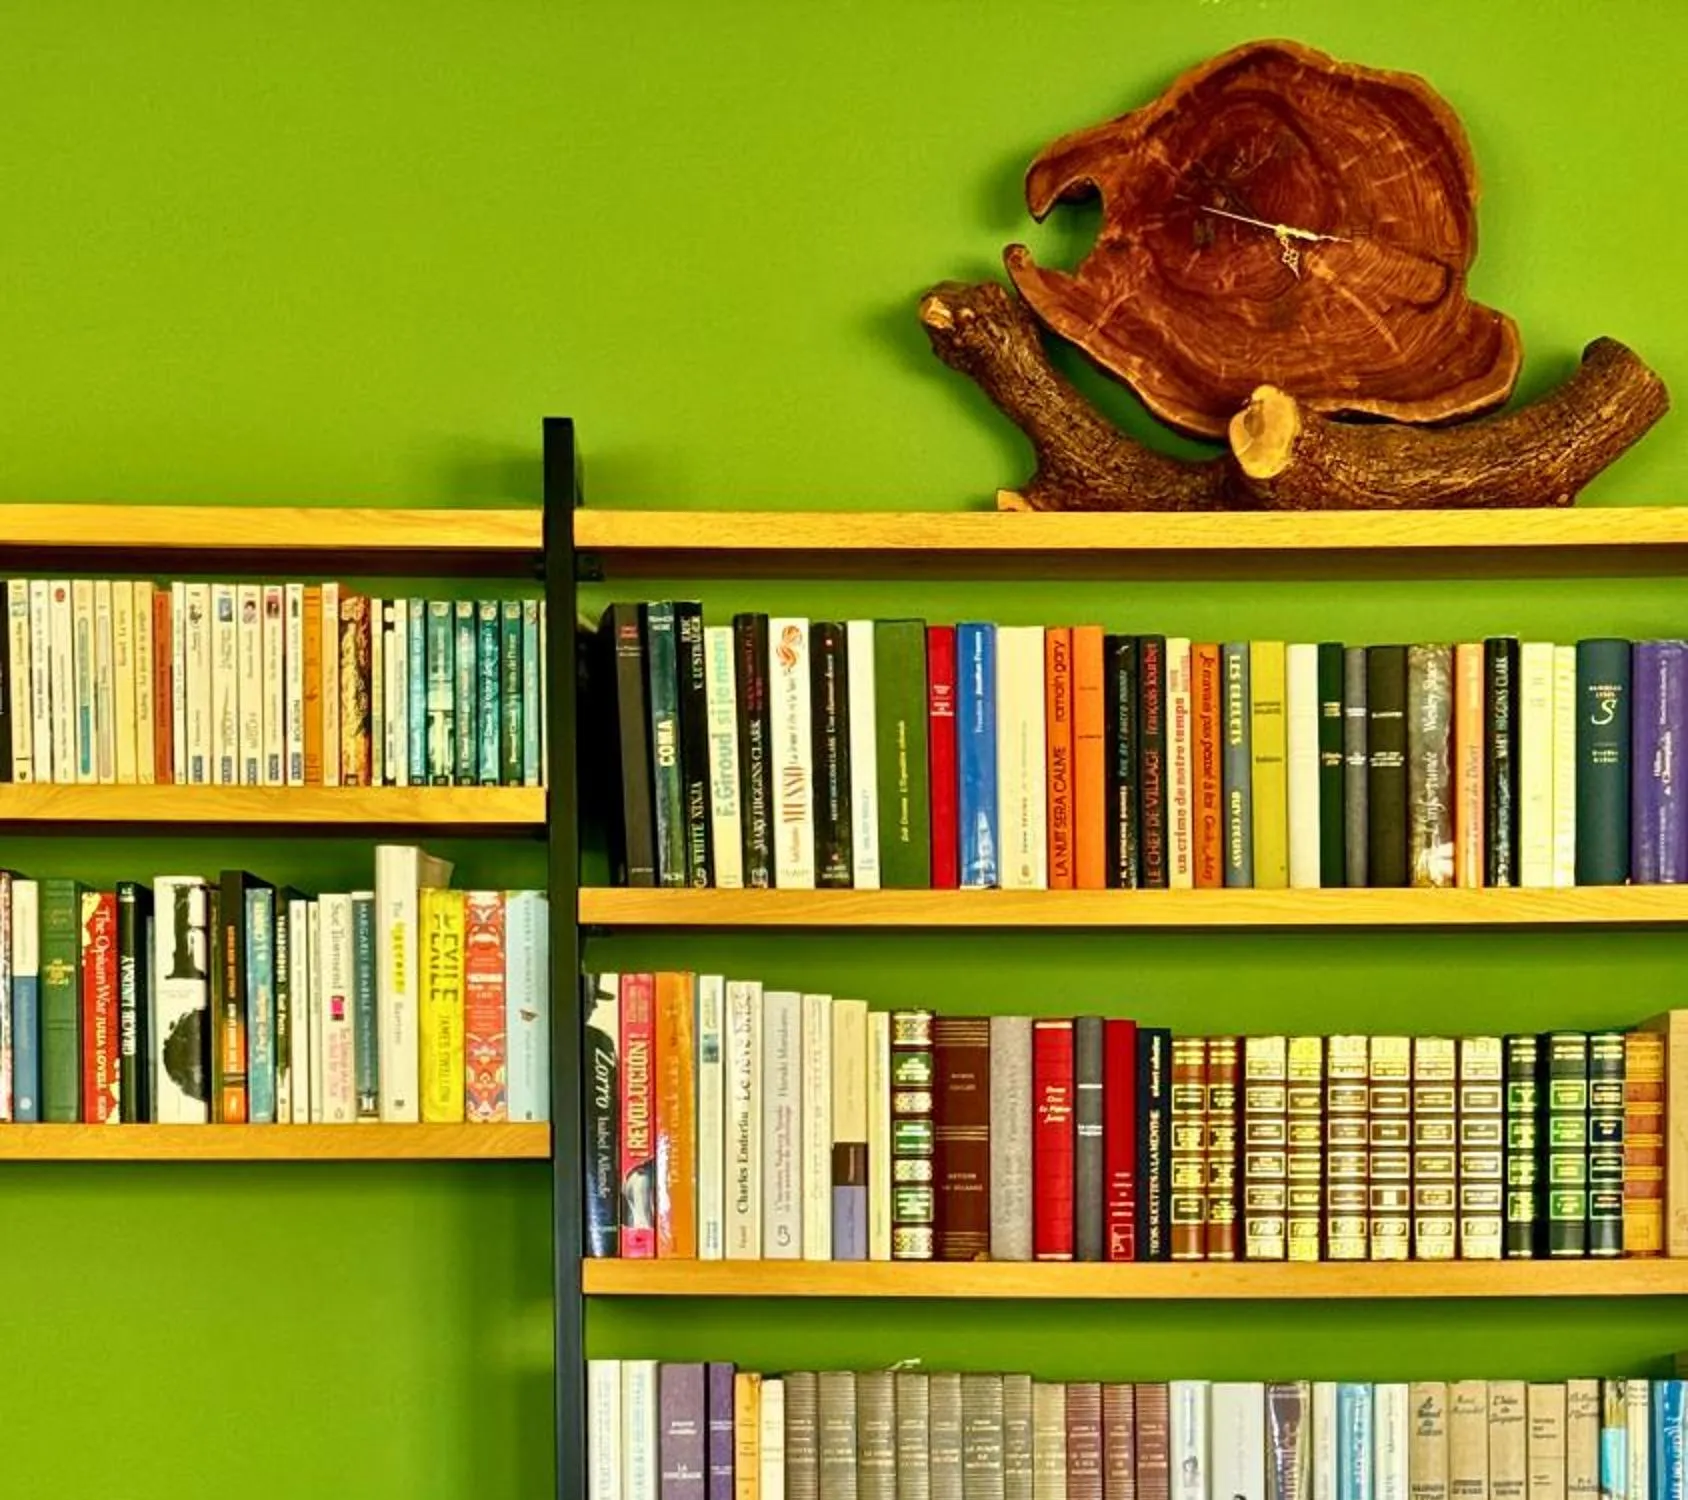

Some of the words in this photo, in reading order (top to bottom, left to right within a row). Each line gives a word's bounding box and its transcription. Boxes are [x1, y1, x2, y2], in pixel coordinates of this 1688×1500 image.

[1053, 640, 1067, 671] gary
[1494, 656, 1508, 687] CLARK
[1053, 676, 1065, 723] romain
[1422, 693, 1445, 732] Wesley
[1173, 697, 1187, 742] temps
[658, 720, 675, 766] COMA
[1053, 747, 1066, 793] CALME
[1145, 748, 1159, 808] VILLAGE
[1174, 746, 1186, 785] notre
[691, 780, 704, 819] NINJA
[1053, 795, 1066, 828] SERA
[1174, 788, 1186, 805] de
[691, 822, 705, 864] WHITE
[1054, 830, 1067, 858] NUIT
[1147, 831, 1160, 865] CHEF
[1175, 808, 1187, 852] crime
[1055, 860, 1068, 877] LA
[1148, 868, 1161, 884] LE
[1176, 855, 1186, 874] un
[95, 907, 111, 934] The
[359, 903, 370, 963] MARGARET
[91, 935, 111, 985] Opium
[95, 985, 111, 1014] War
[121, 955, 136, 1008] LINDSAY
[361, 965, 370, 1011] DRABBLE
[96, 1016, 108, 1047] JULIA
[595, 1047, 616, 1109] Zorro
[598, 1115, 610, 1150] Isabel
[598, 1152, 610, 1198] Allende
[737, 1167, 750, 1215] Charles
